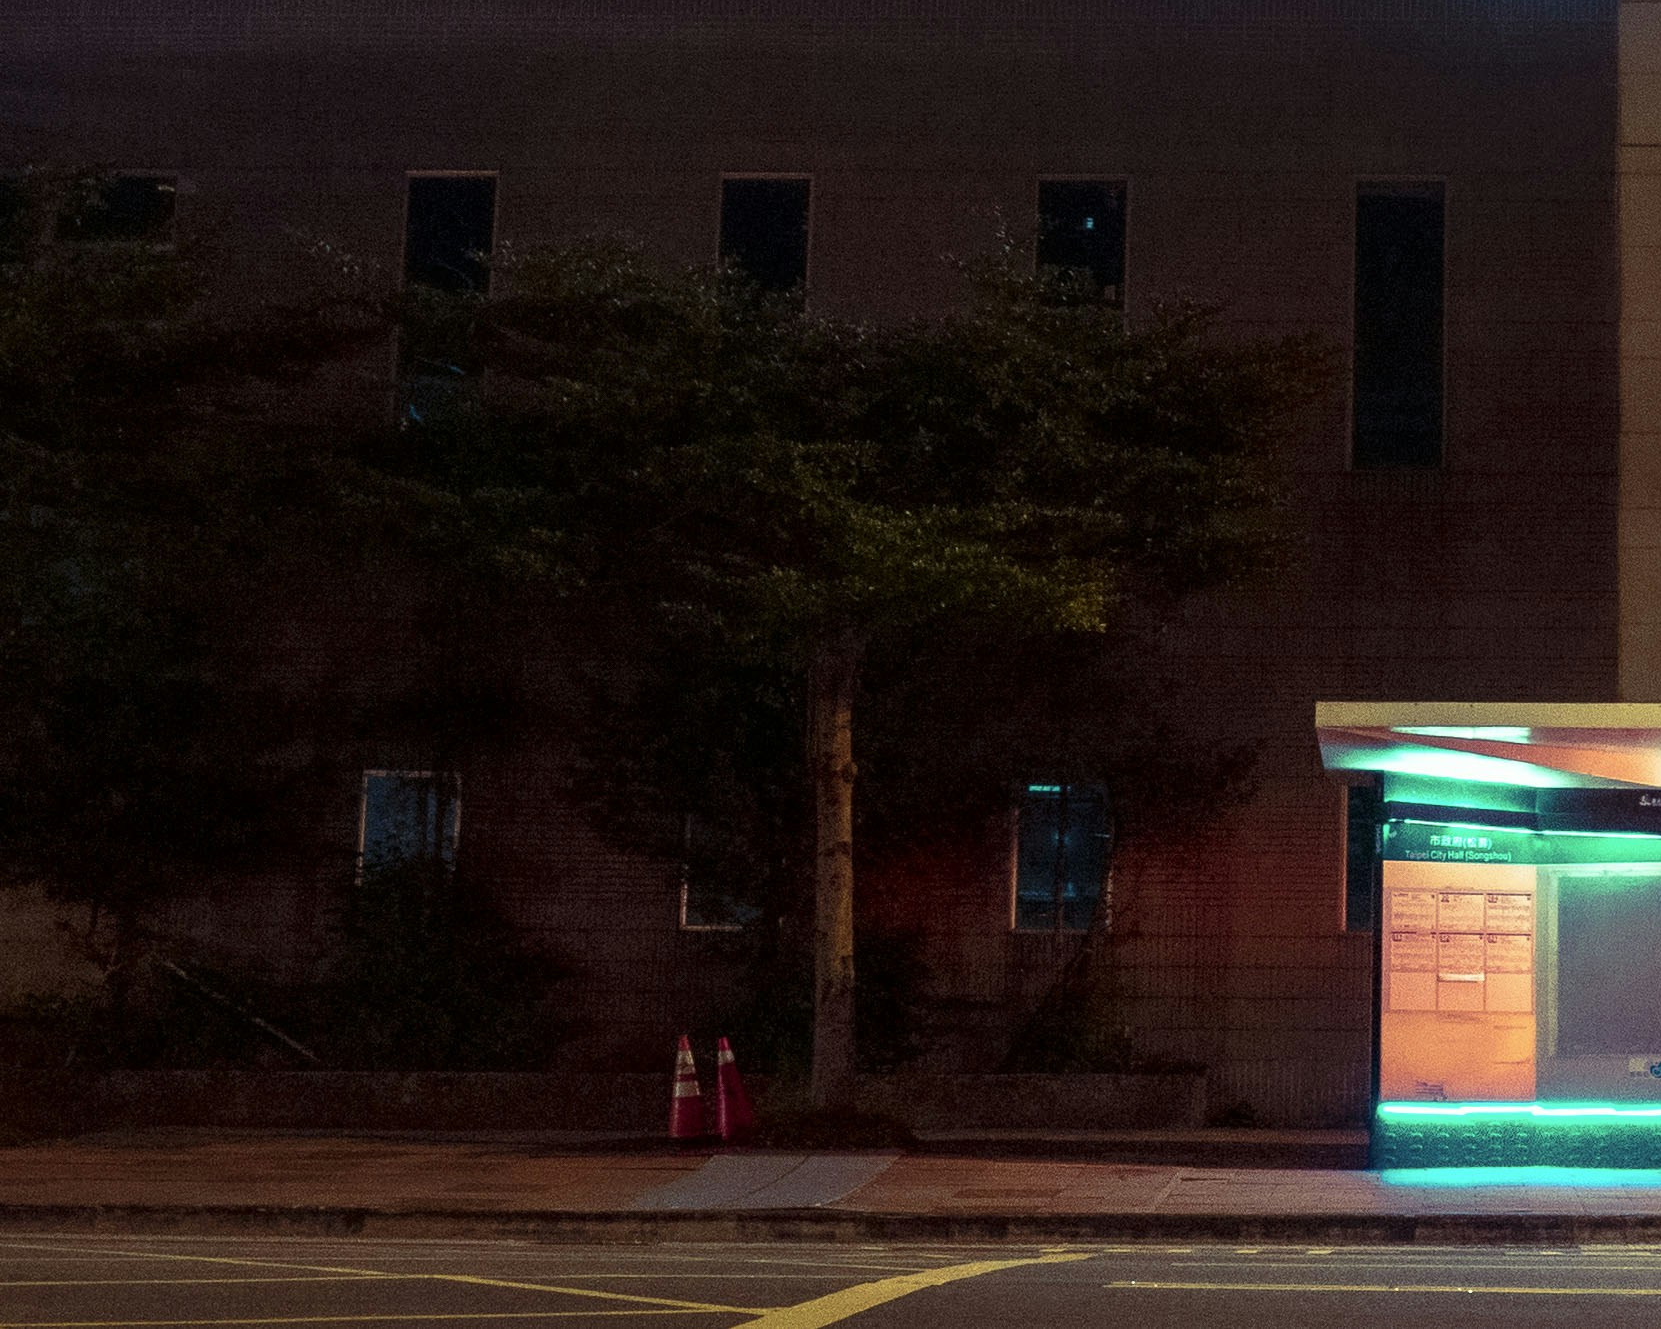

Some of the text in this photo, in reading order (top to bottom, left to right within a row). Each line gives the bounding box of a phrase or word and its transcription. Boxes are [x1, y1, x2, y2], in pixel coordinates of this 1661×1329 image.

[1405, 850, 1512, 862] Taipei City Hall (Songshou)
